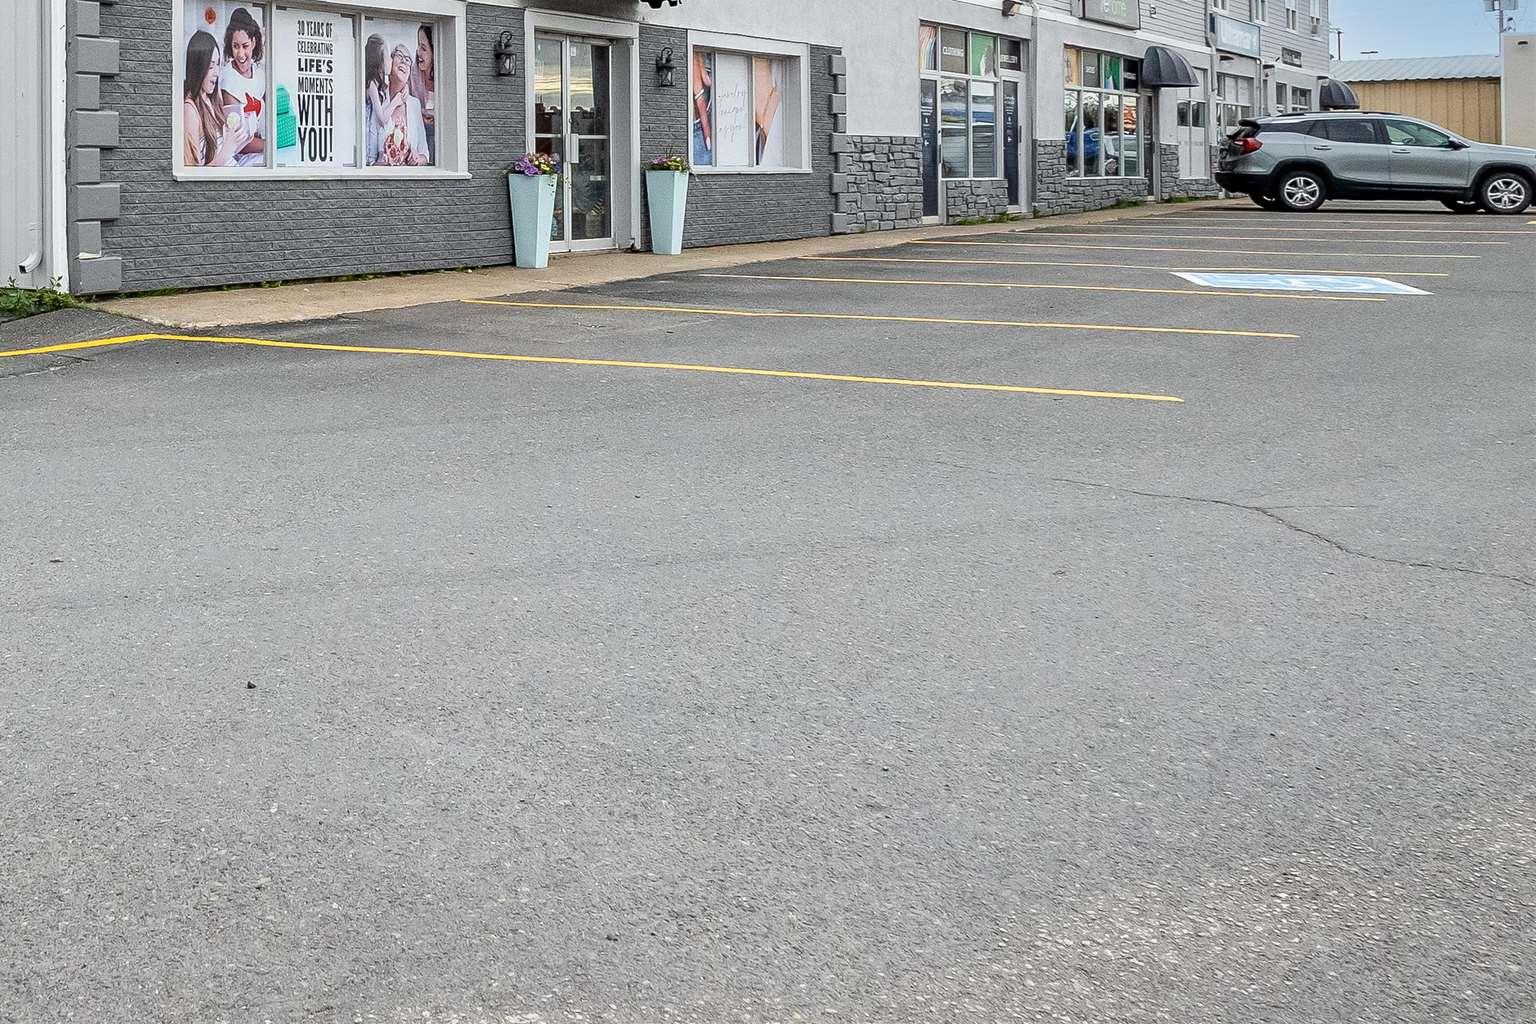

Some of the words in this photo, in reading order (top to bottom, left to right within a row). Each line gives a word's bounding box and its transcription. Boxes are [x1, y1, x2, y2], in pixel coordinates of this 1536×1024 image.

[306, 20, 325, 37] YEARS
[326, 22, 333, 38] OF
[297, 40, 334, 56] CELEBRATING
[298, 57, 334, 74] LIFE'S
[297, 76, 334, 94] MOMENTS
[297, 93, 334, 127] WITH
[297, 126, 333, 162] YOU!
